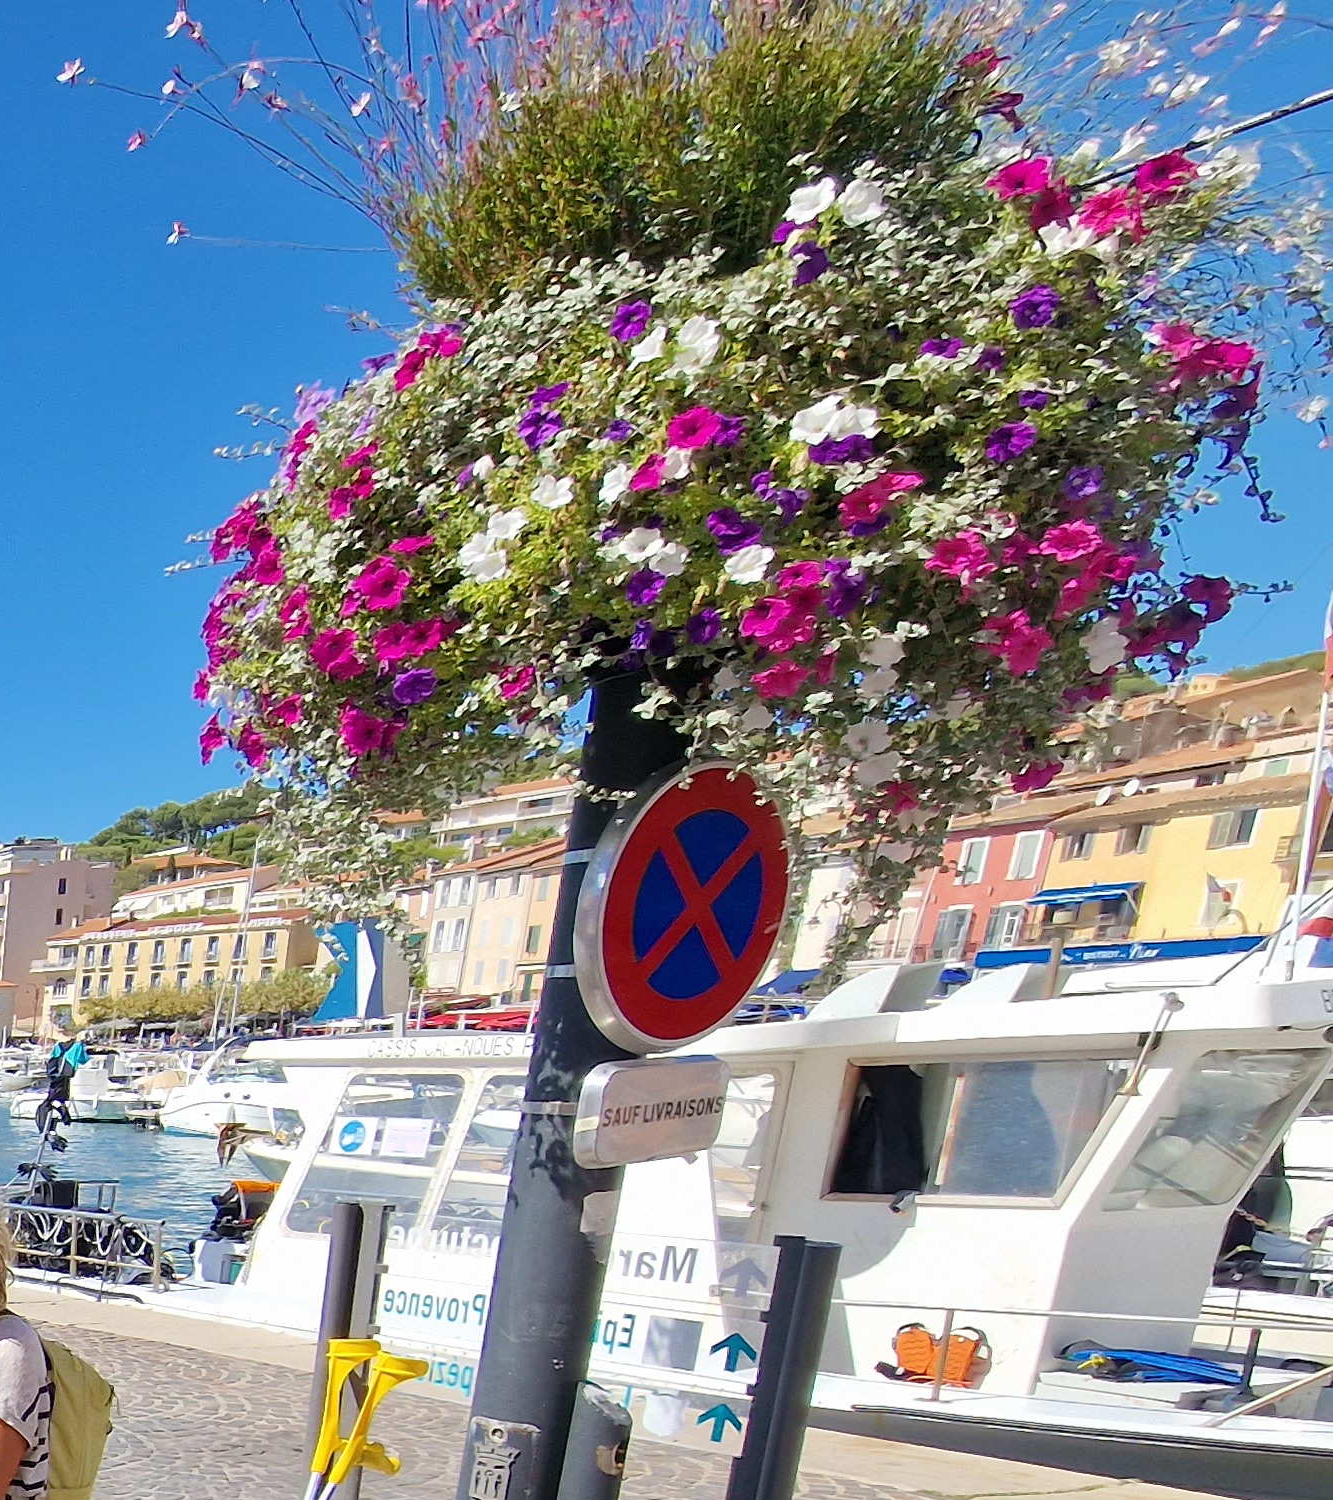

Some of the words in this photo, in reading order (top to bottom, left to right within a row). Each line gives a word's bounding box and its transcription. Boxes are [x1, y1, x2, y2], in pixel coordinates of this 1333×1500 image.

[368, 1038, 417, 1058] CASSIS
[602, 1105, 642, 1127] SAUF
[643, 1096, 724, 1123] LIVRAISONS
